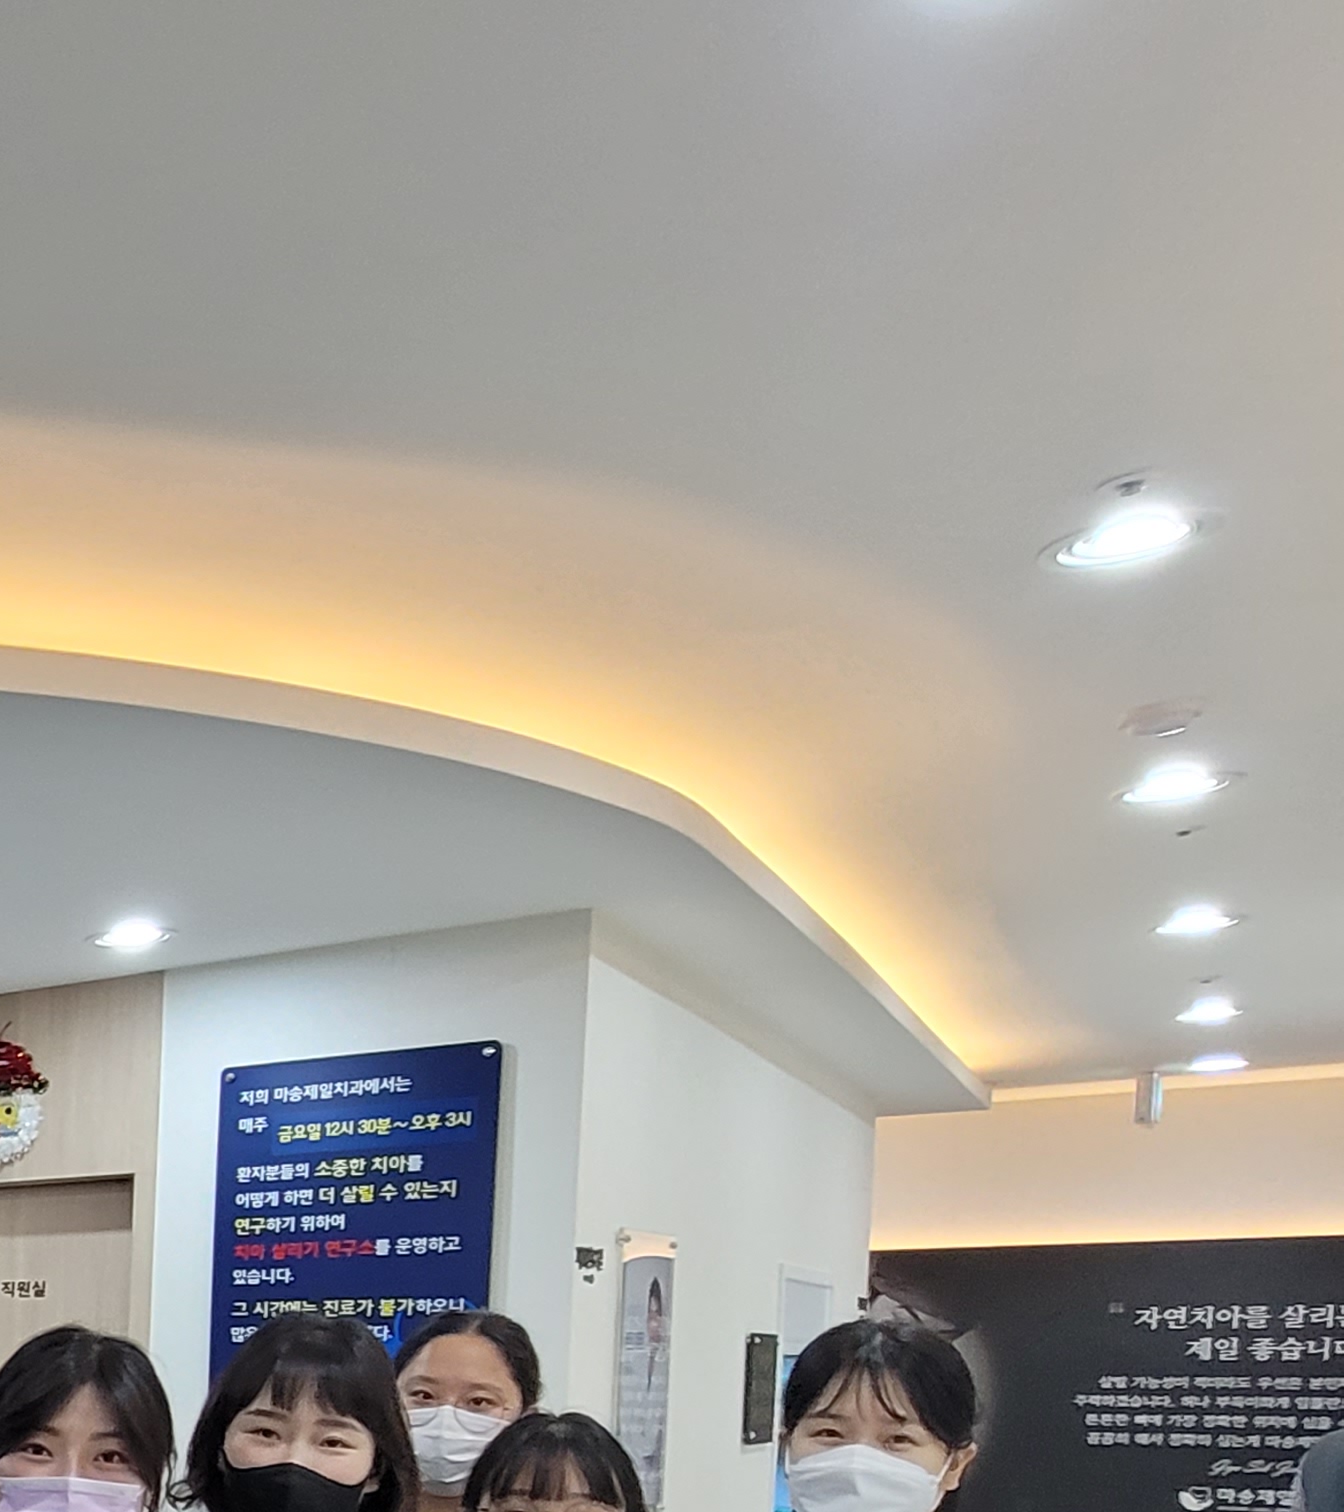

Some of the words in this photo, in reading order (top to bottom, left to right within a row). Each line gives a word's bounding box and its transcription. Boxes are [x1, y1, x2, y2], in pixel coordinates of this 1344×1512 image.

[239, 1089, 269, 1106] 저희
[273, 1076, 413, 1103] 마송제일치과에서는
[238, 1116, 268, 1133] 매주
[277, 1125, 321, 1143] 금요일
[325, 1120, 354, 1137] 12시
[445, 1111, 472, 1126] 3시
[236, 1163, 310, 1183] 환자분들의
[314, 1158, 365, 1178] 소중한
[370, 1155, 424, 1174] 치아를
[235, 1191, 279, 1209] 어떻게
[283, 1188, 313, 1206] 하면
[318, 1186, 336, 1203] 더
[340, 1184, 375, 1202] 살릴
[379, 1183, 399, 1200] 수
[404, 1179, 458, 1200] 있는지
[234, 1217, 296, 1235] 연구하기
[300, 1213, 346, 1231] 위하여
[234, 1244, 265, 1260] 치아
[271, 1241, 319, 1260] 살리기
[324, 1238, 391, 1258] 연구소를
[395, 1235, 462, 1256] 운영하고
[1, 1280, 46, 1298] 직원실
[232, 1268, 295, 1285] 있습니다.
[230, 1301, 249, 1316] 그
[322, 1298, 375, 1318] 진료가
[1134, 1304, 1272, 1330] 자연치아를
[1184, 1336, 1240, 1361] 제일
